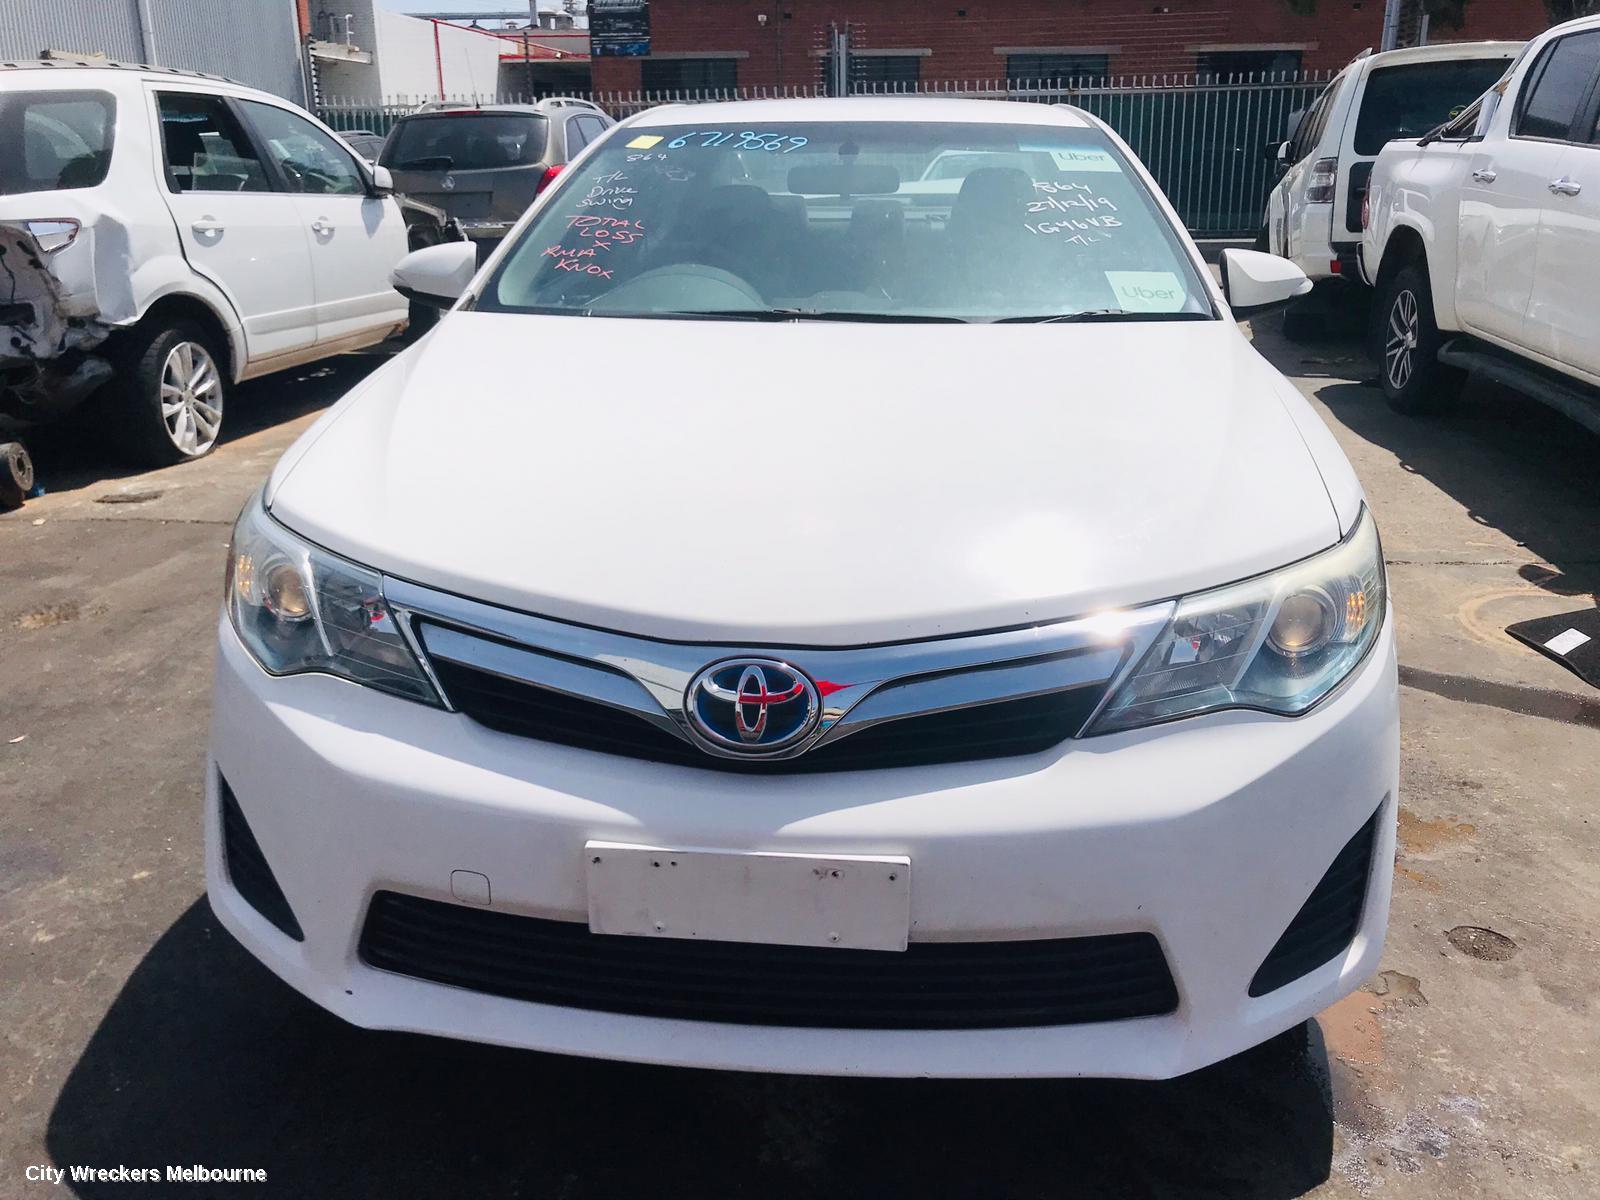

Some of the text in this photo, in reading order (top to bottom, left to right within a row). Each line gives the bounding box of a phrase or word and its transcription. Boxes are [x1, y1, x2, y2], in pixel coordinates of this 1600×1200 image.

[1059, 152, 1105, 161] Uber
[565, 215, 645, 229] TOTAL
[579, 227, 643, 244] LOSS
[554, 258, 614, 280] KNOX
[1121, 285, 1176, 300] Uber
